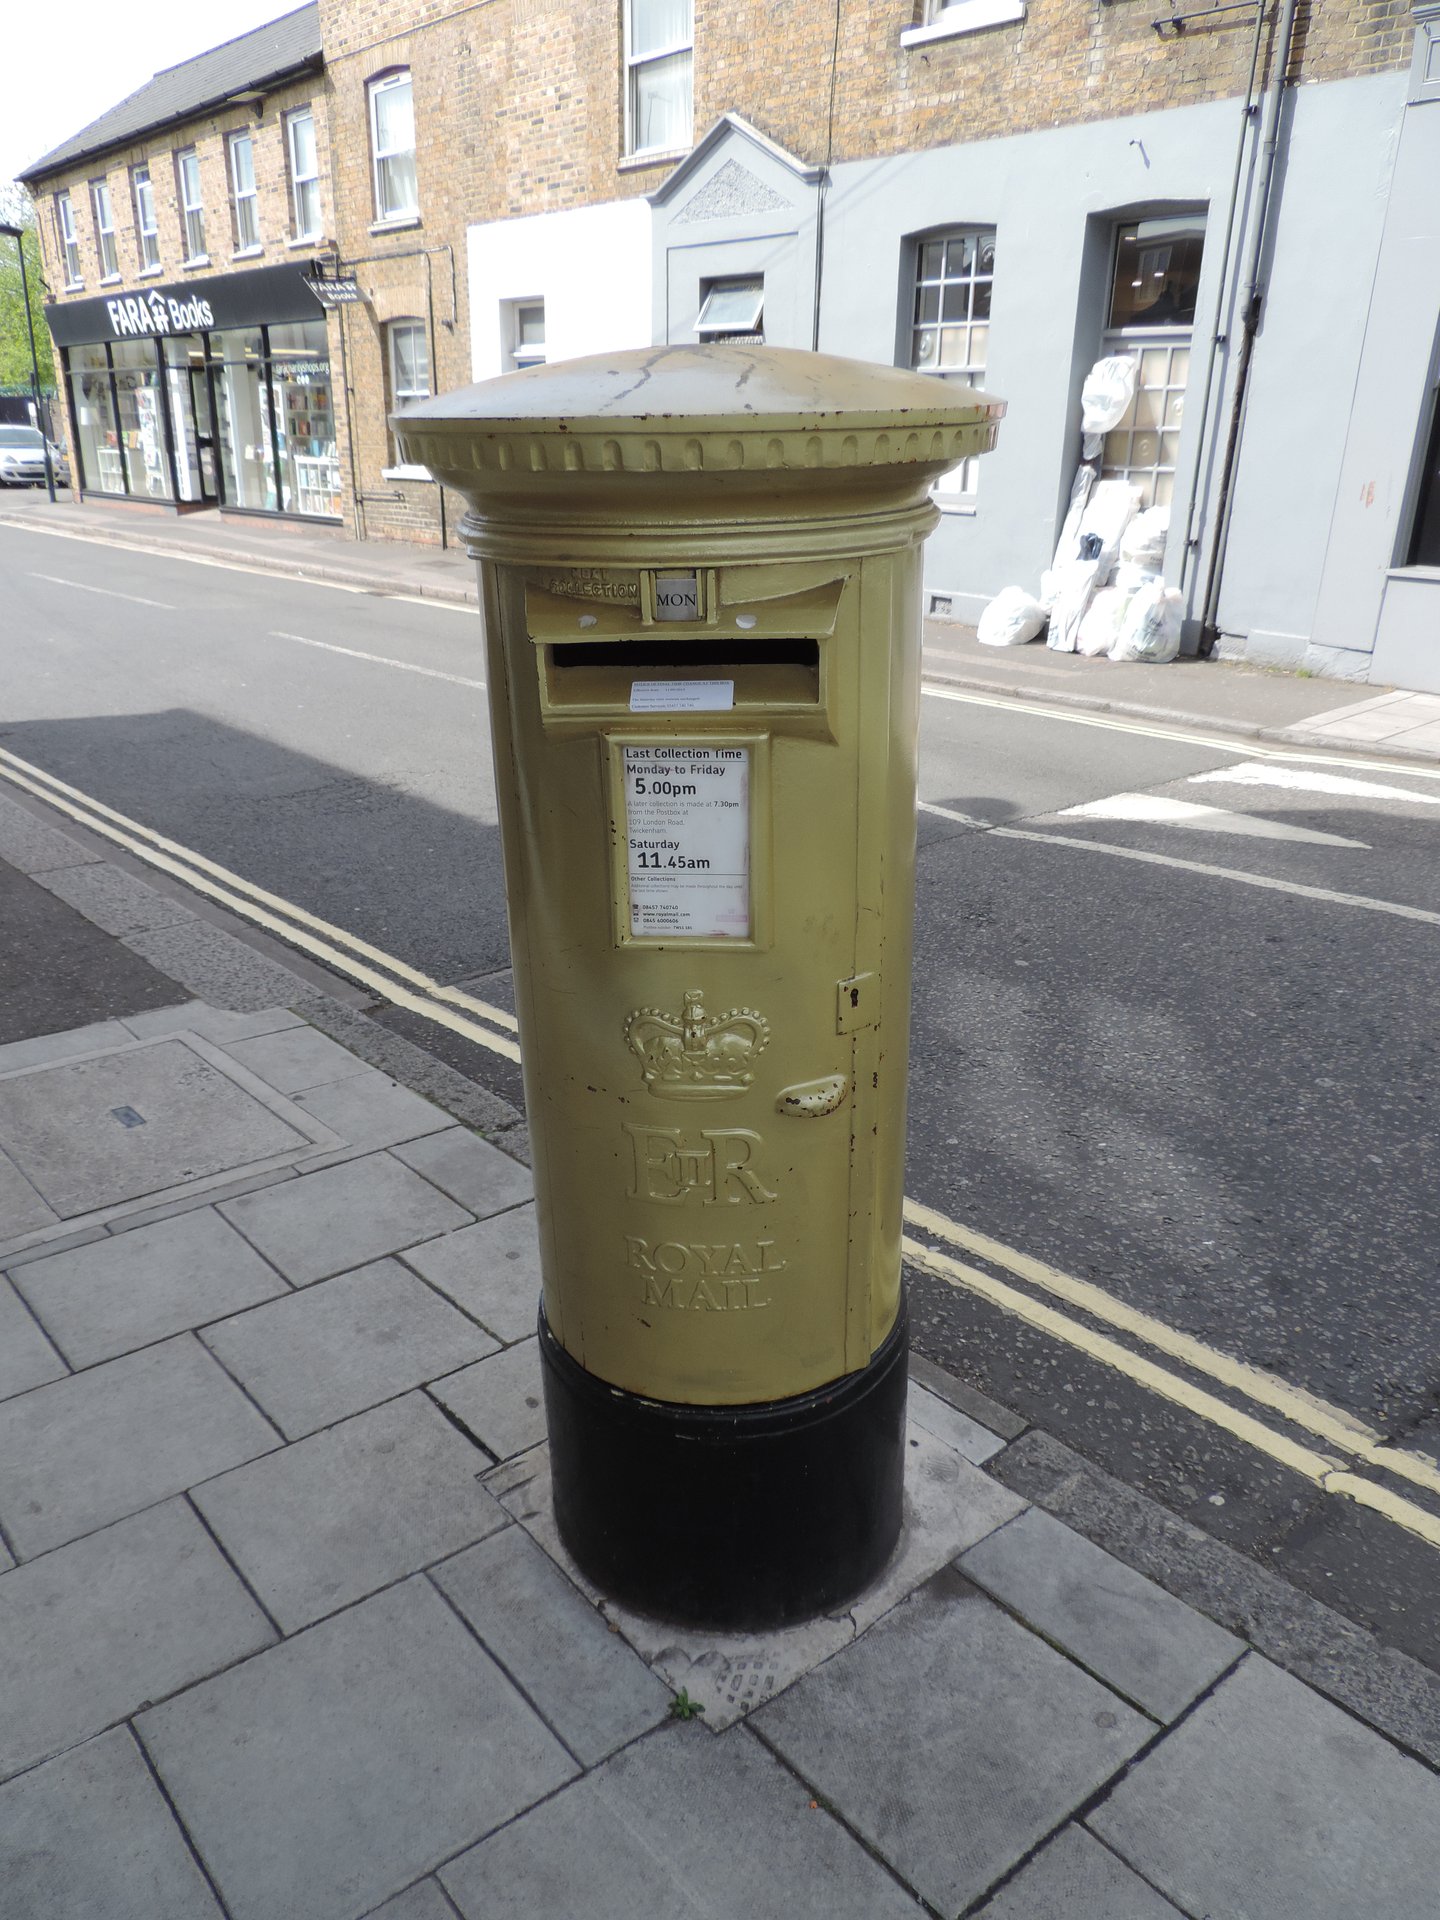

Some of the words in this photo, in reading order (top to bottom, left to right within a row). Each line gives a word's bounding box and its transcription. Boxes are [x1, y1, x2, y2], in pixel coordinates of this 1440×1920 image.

[310, 281, 345, 291] FARA
[107, 296, 156, 336] FARA
[167, 294, 215, 331] Books
[551, 580, 638, 599] COLLECTION
[656, 593, 697, 607] MON
[626, 748, 651, 759] Last
[654, 748, 710, 759] Collection
[715, 748, 742, 759] Time
[626, 764, 671, 776] Monday
[674, 766, 686, 775] to
[690, 764, 726, 777] Friday
[635, 777, 697, 798] 5.00pm
[629, 839, 680, 851] Saturday
[637, 851, 710, 869] 11.45am
[623, 1235, 787, 1276] ROYAL
[641, 1275, 773, 1312] MAIL
